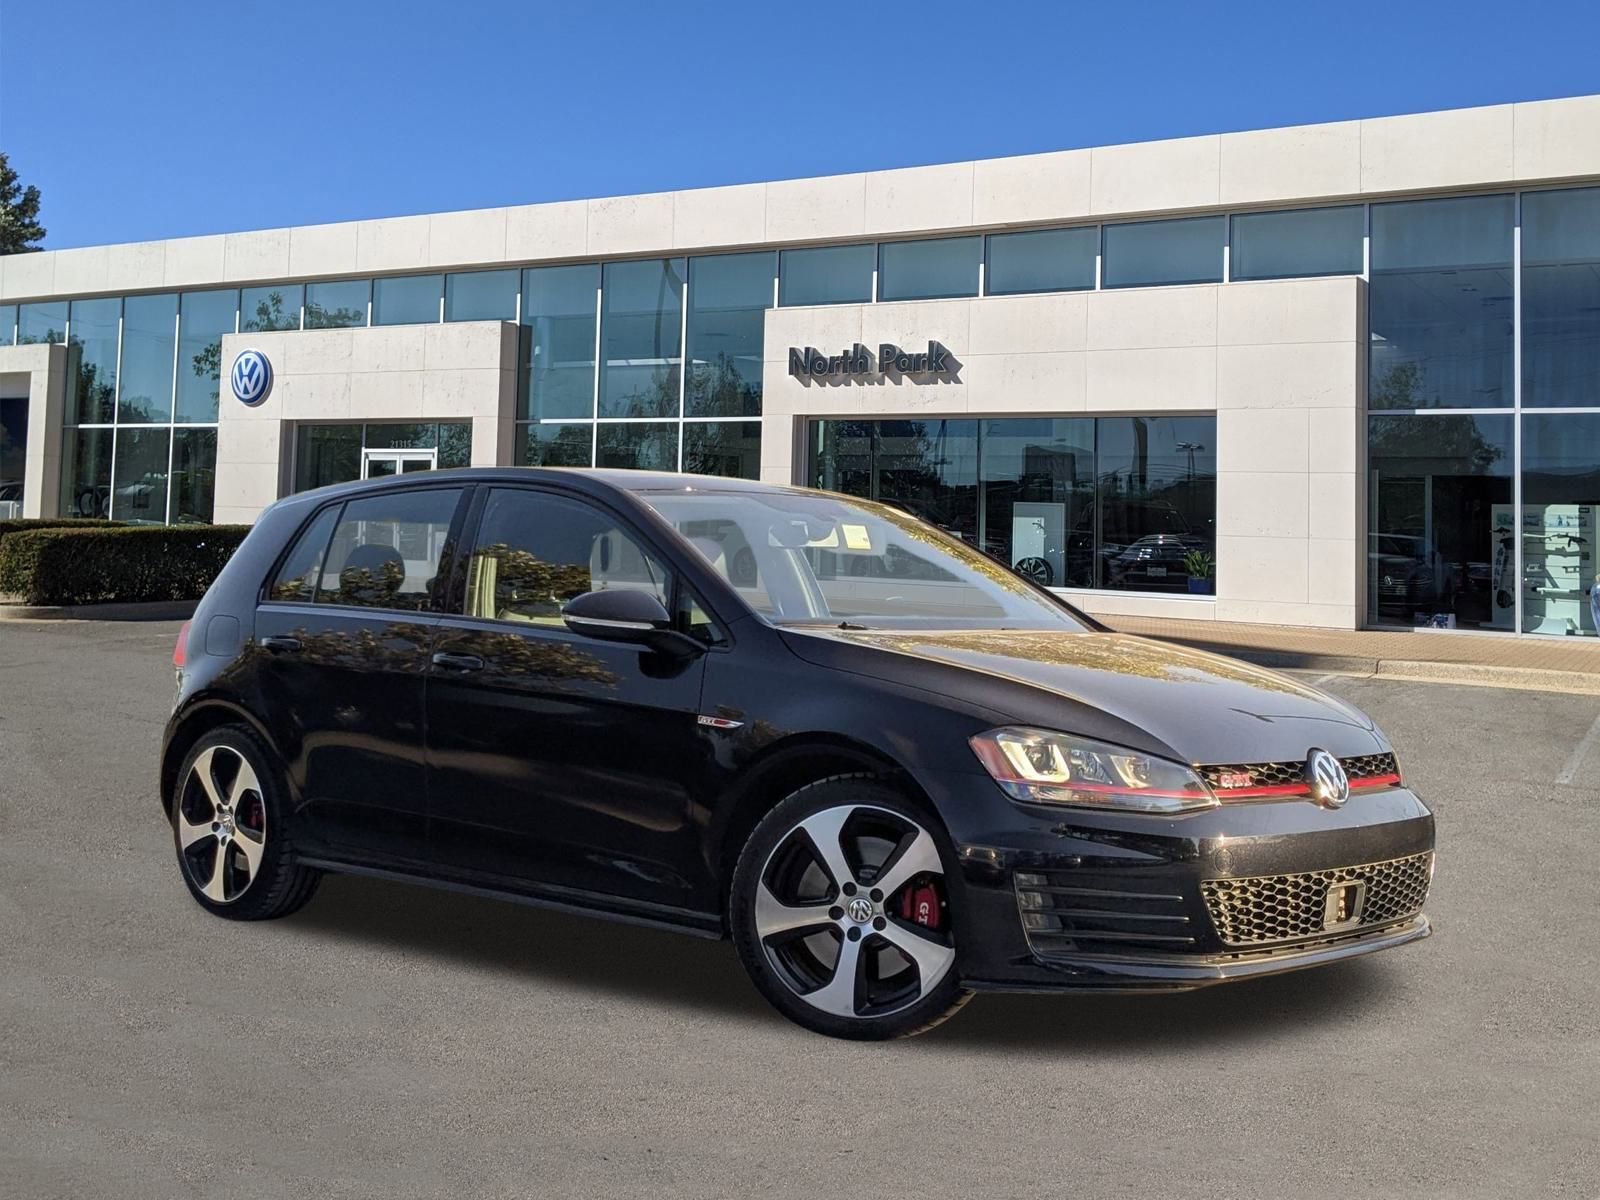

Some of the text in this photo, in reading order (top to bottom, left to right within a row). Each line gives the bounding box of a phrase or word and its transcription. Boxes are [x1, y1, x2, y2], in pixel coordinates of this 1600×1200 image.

[232, 351, 266, 401] VW
[788, 340, 947, 376] North Park
[1219, 773, 1252, 788] GTI
